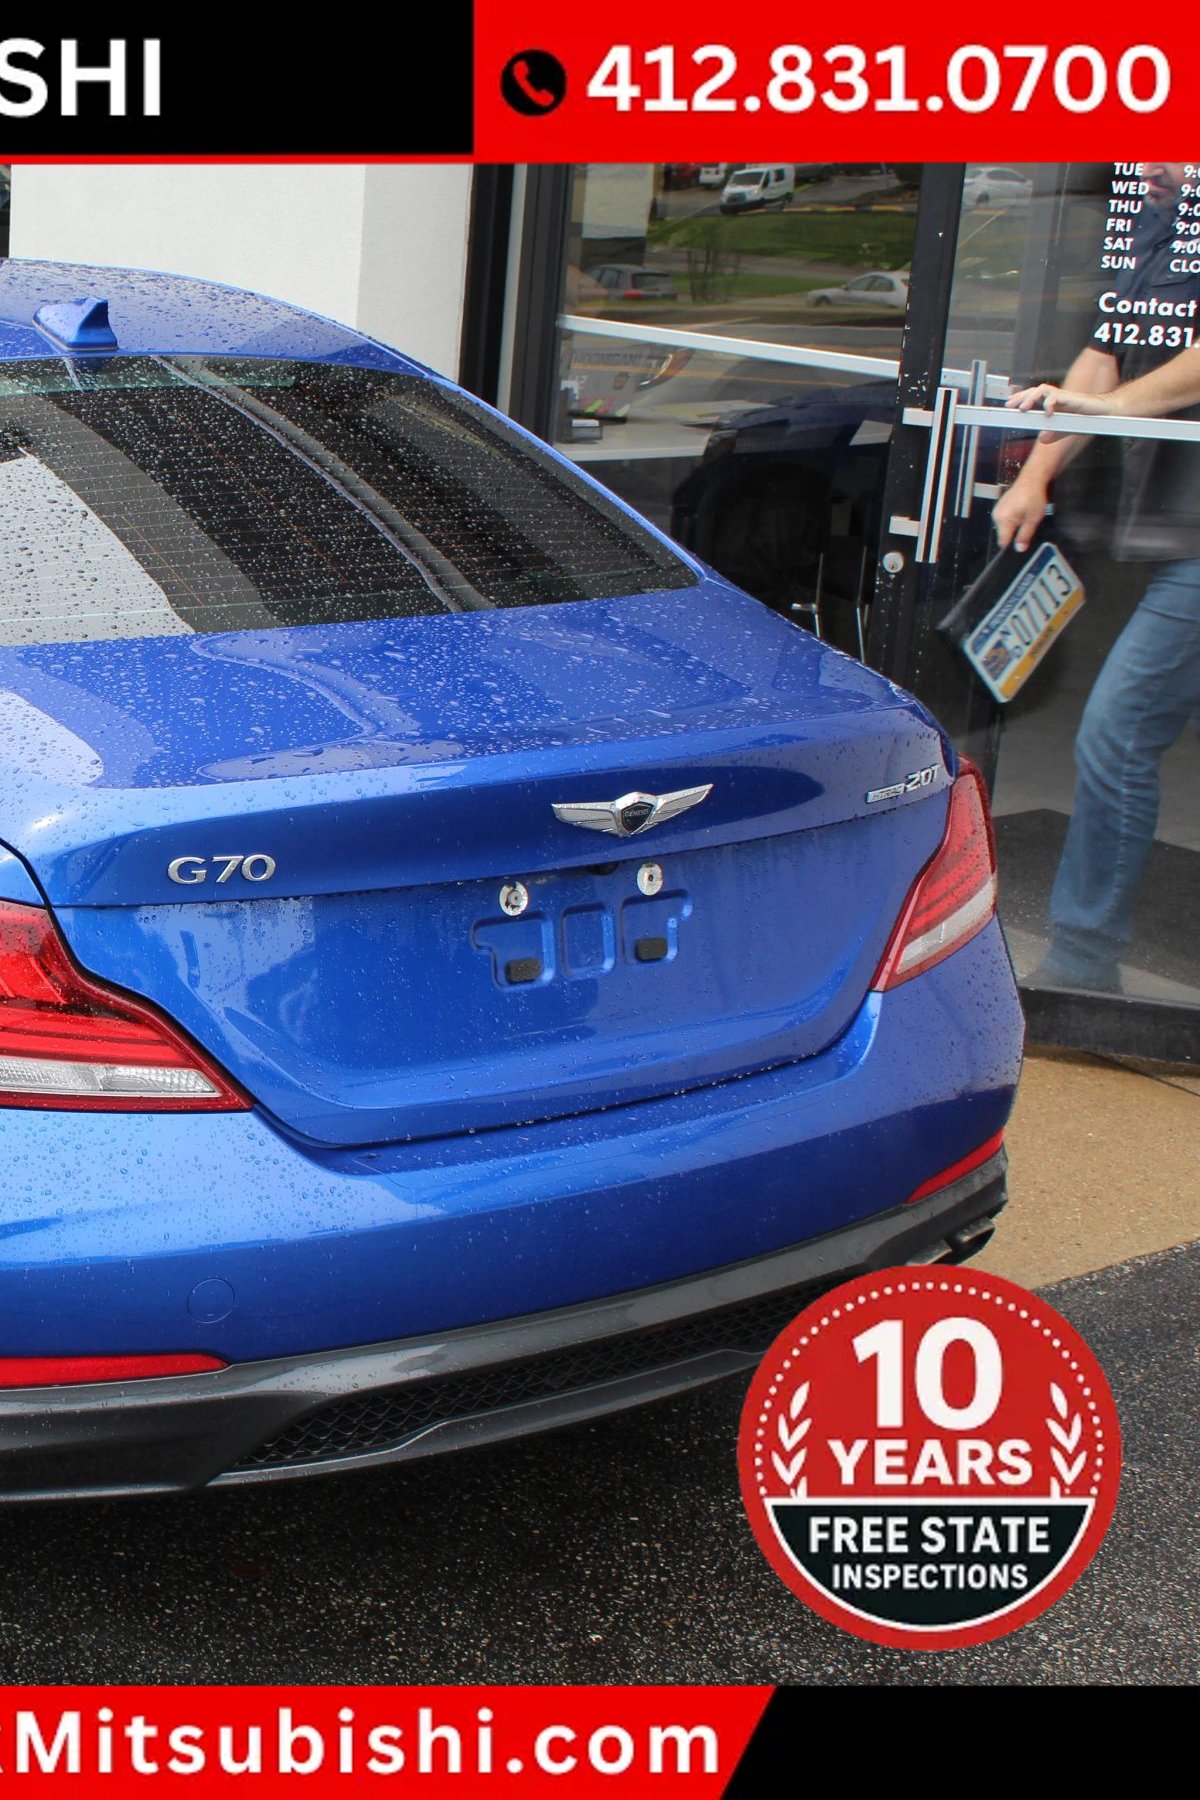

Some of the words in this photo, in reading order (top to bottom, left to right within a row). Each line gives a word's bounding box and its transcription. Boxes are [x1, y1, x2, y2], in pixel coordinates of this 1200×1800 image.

[1113, 162, 1144, 176] TUE
[1184, 165, 1200, 178] 9:
[1111, 180, 1149, 195] WED
[1109, 199, 1142, 213] THU
[1106, 218, 1132, 232] FRI
[1103, 237, 1133, 250] SAT
[1101, 255, 1136, 269] SUN
[1099, 292, 1197, 317] Contact
[167, 854, 276, 885] G70
